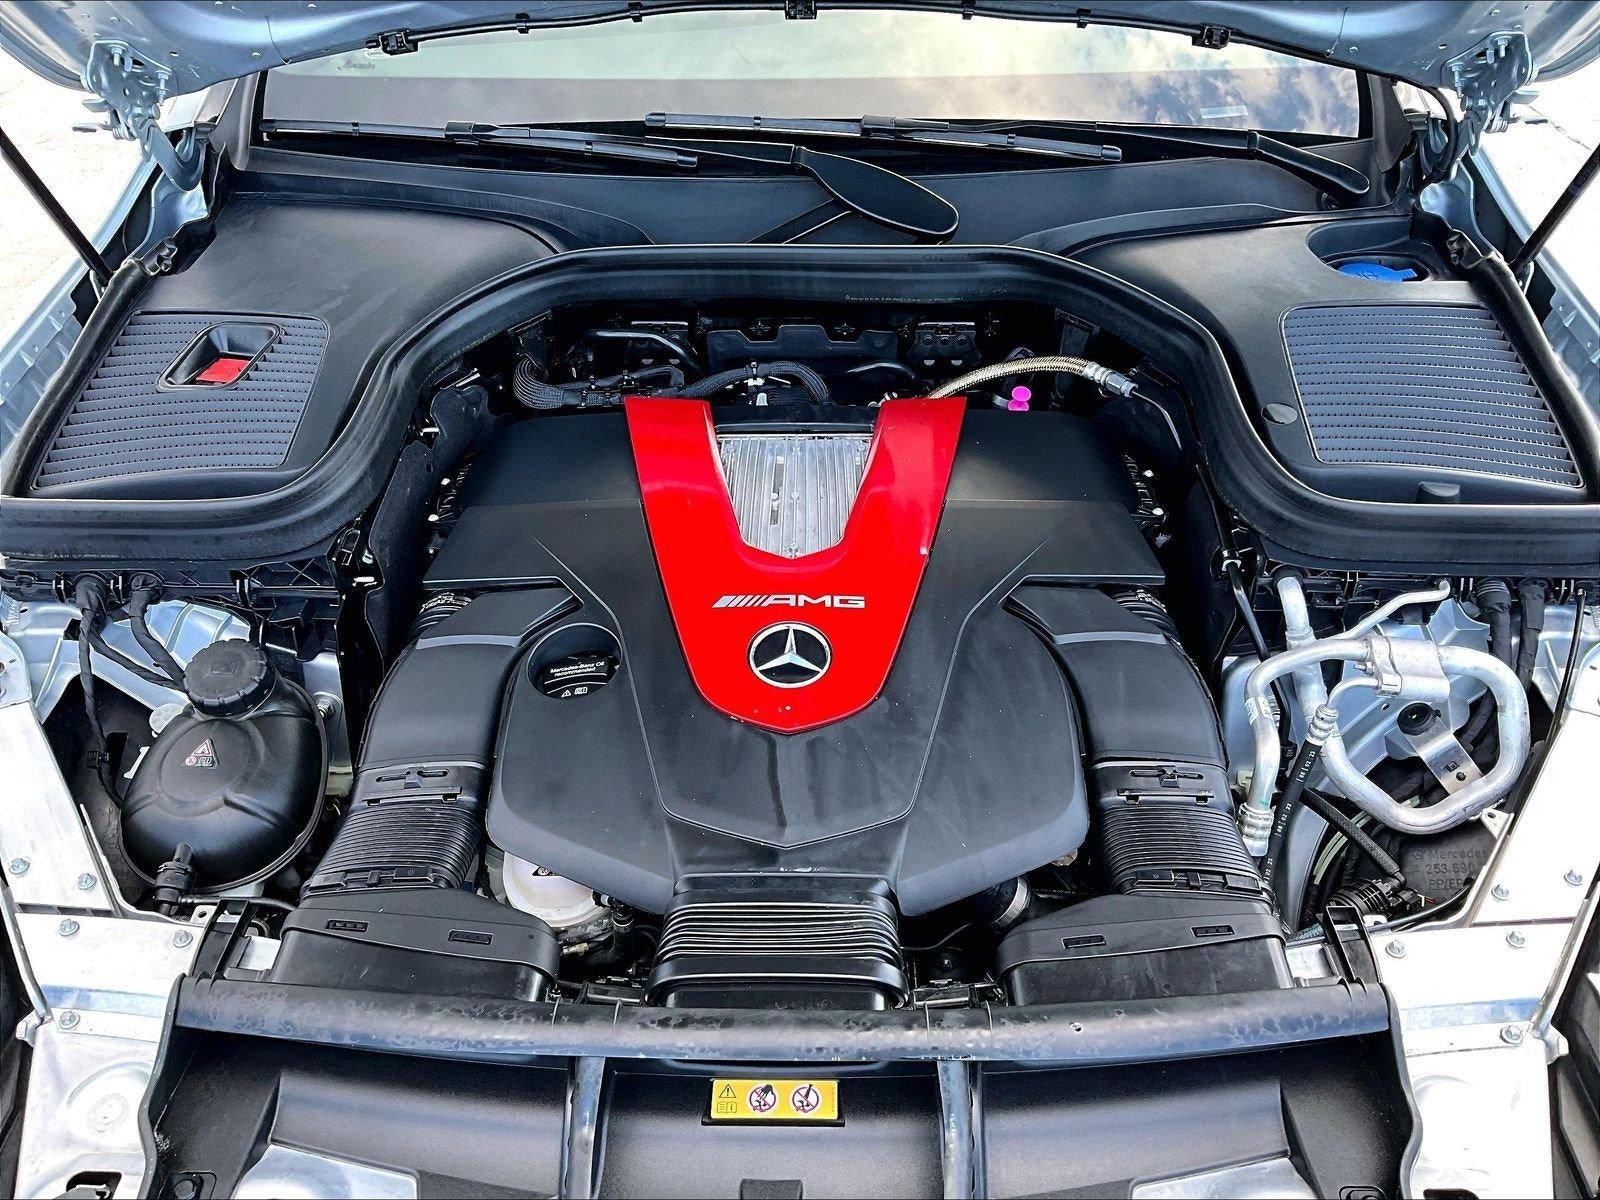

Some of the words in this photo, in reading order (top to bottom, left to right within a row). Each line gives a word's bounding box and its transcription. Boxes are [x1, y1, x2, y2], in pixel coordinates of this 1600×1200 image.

[761, 594, 866, 609] AMG
[550, 662, 595, 674] Mercedes-Benz
[554, 667, 596, 677] recommended
[1425, 863, 1448, 875] 253
